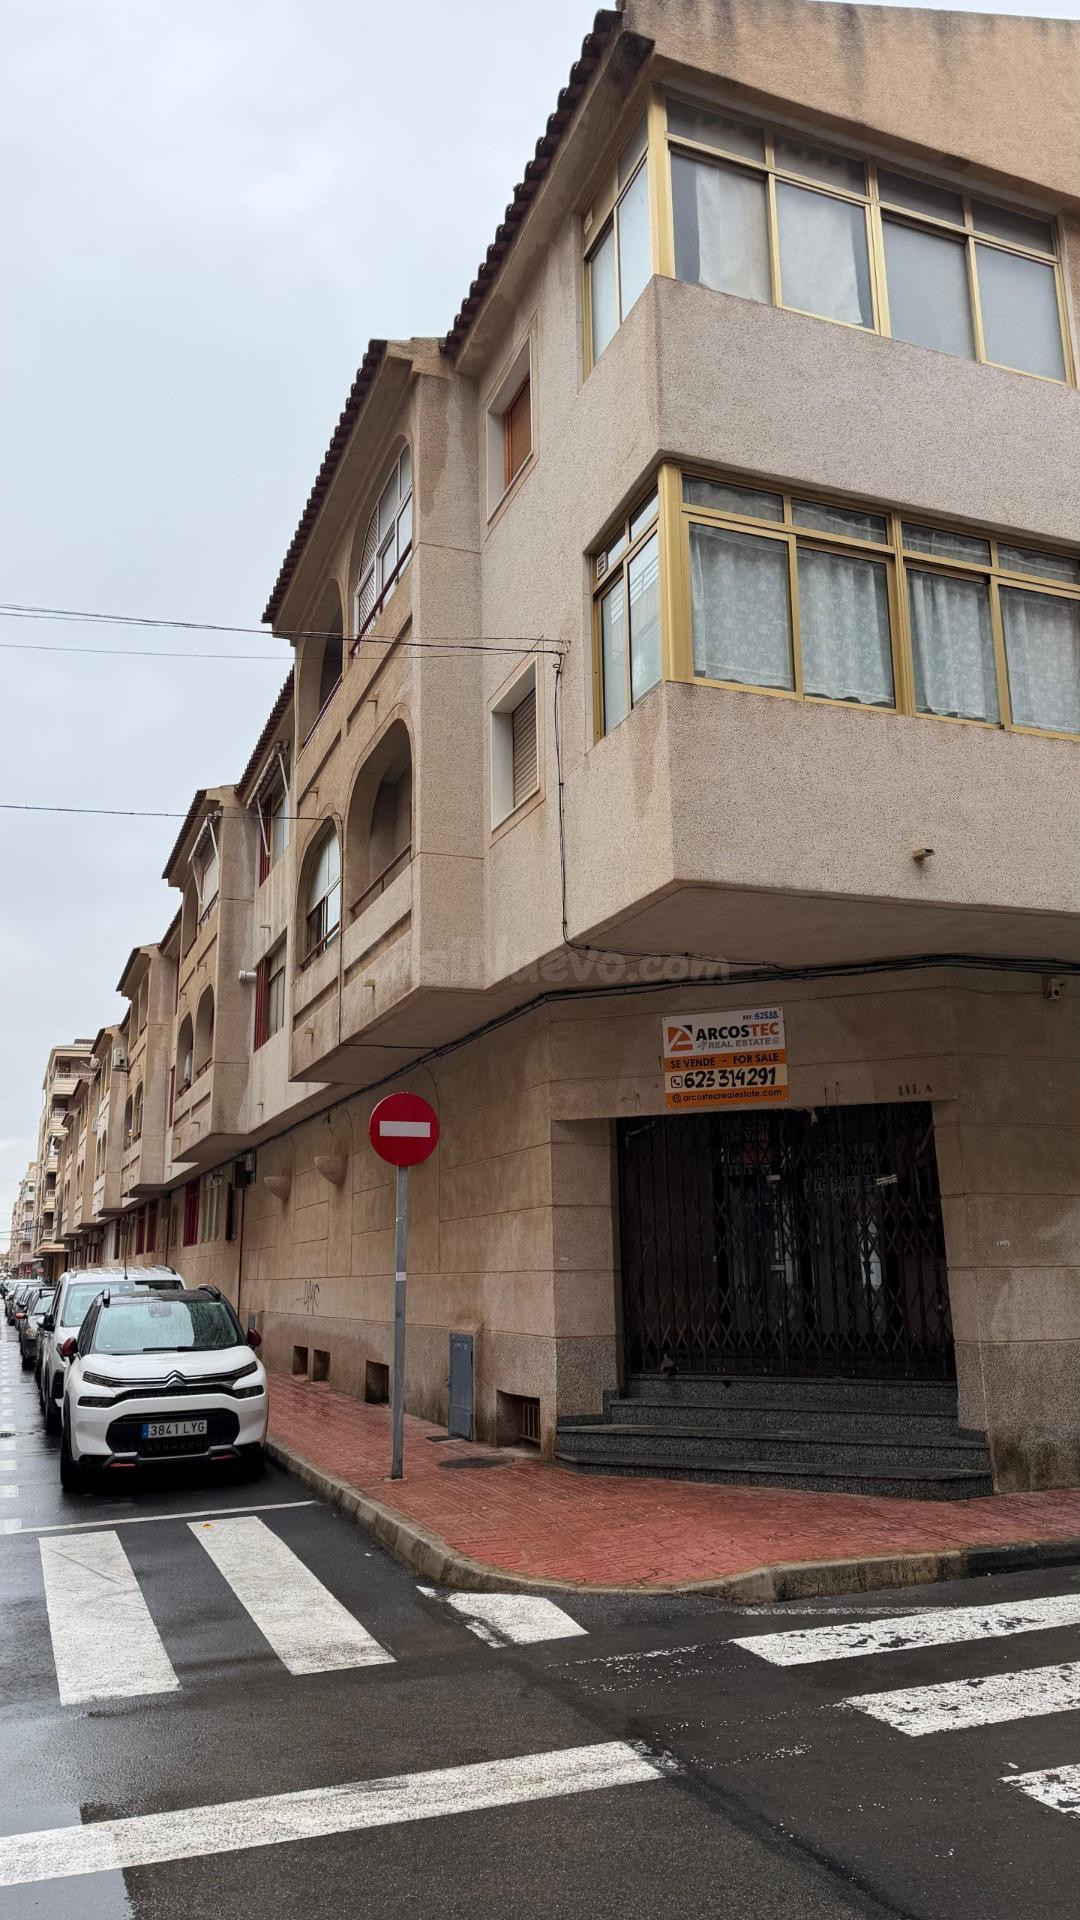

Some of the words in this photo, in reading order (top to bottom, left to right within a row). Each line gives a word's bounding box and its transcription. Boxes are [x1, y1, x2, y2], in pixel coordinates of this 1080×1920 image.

[695, 1022, 779, 1041] ARCOSTEC
[708, 1041, 734, 1049] REAL
[735, 1037, 771, 1047] ESTATE
[670, 1060, 680, 1069] SE
[684, 1058, 715, 1068] VENDE
[733, 1054, 752, 1064] FOR
[755, 1053, 779, 1063] SALE
[683, 1090, 782, 1102] arcostecrealestate.com
[150, 1424, 179, 1436] 3841
[183, 1422, 205, 1434] LYG
